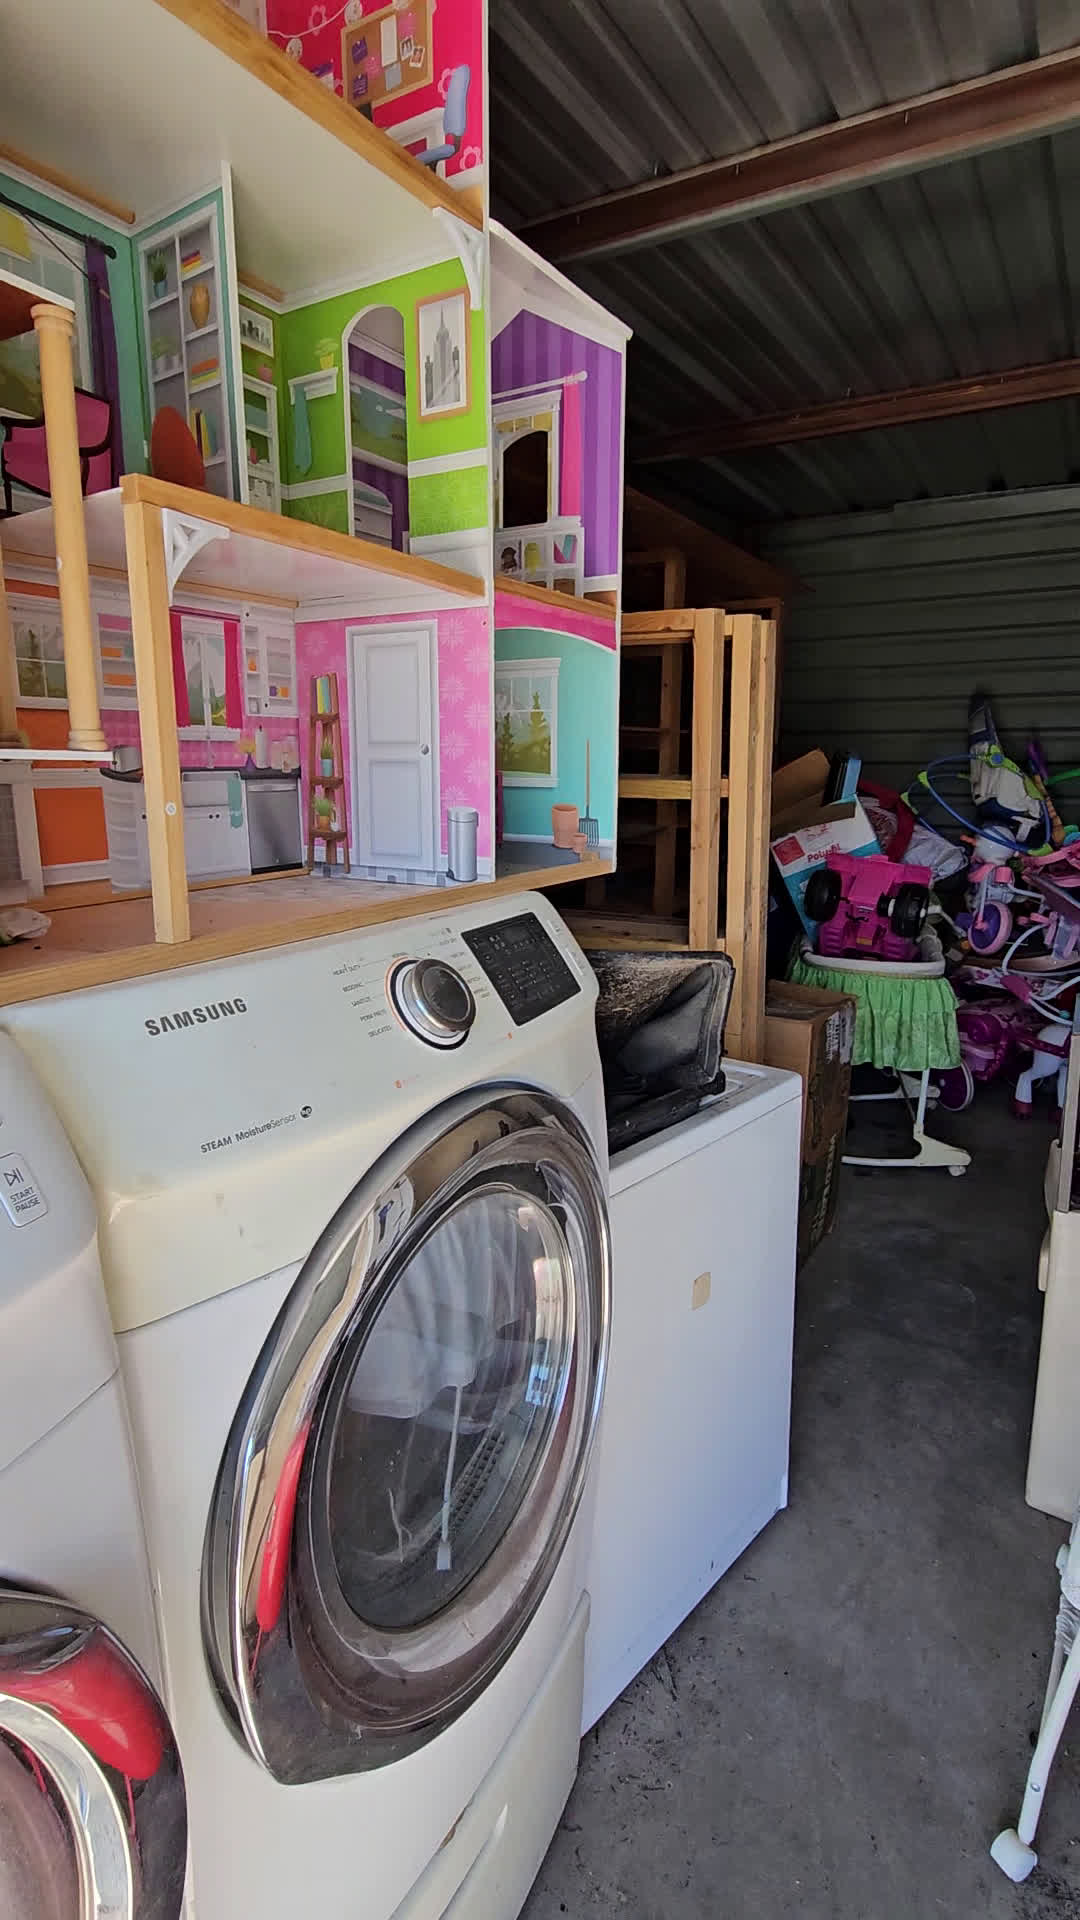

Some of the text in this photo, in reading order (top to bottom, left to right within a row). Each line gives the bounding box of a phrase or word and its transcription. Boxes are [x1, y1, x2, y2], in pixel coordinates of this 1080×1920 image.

[144, 998, 247, 1036] SAMSUNG
[200, 1136, 232, 1153] STEAM
[9, 1186, 34, 1203] START
[14, 1197, 41, 1213] PAUSE
